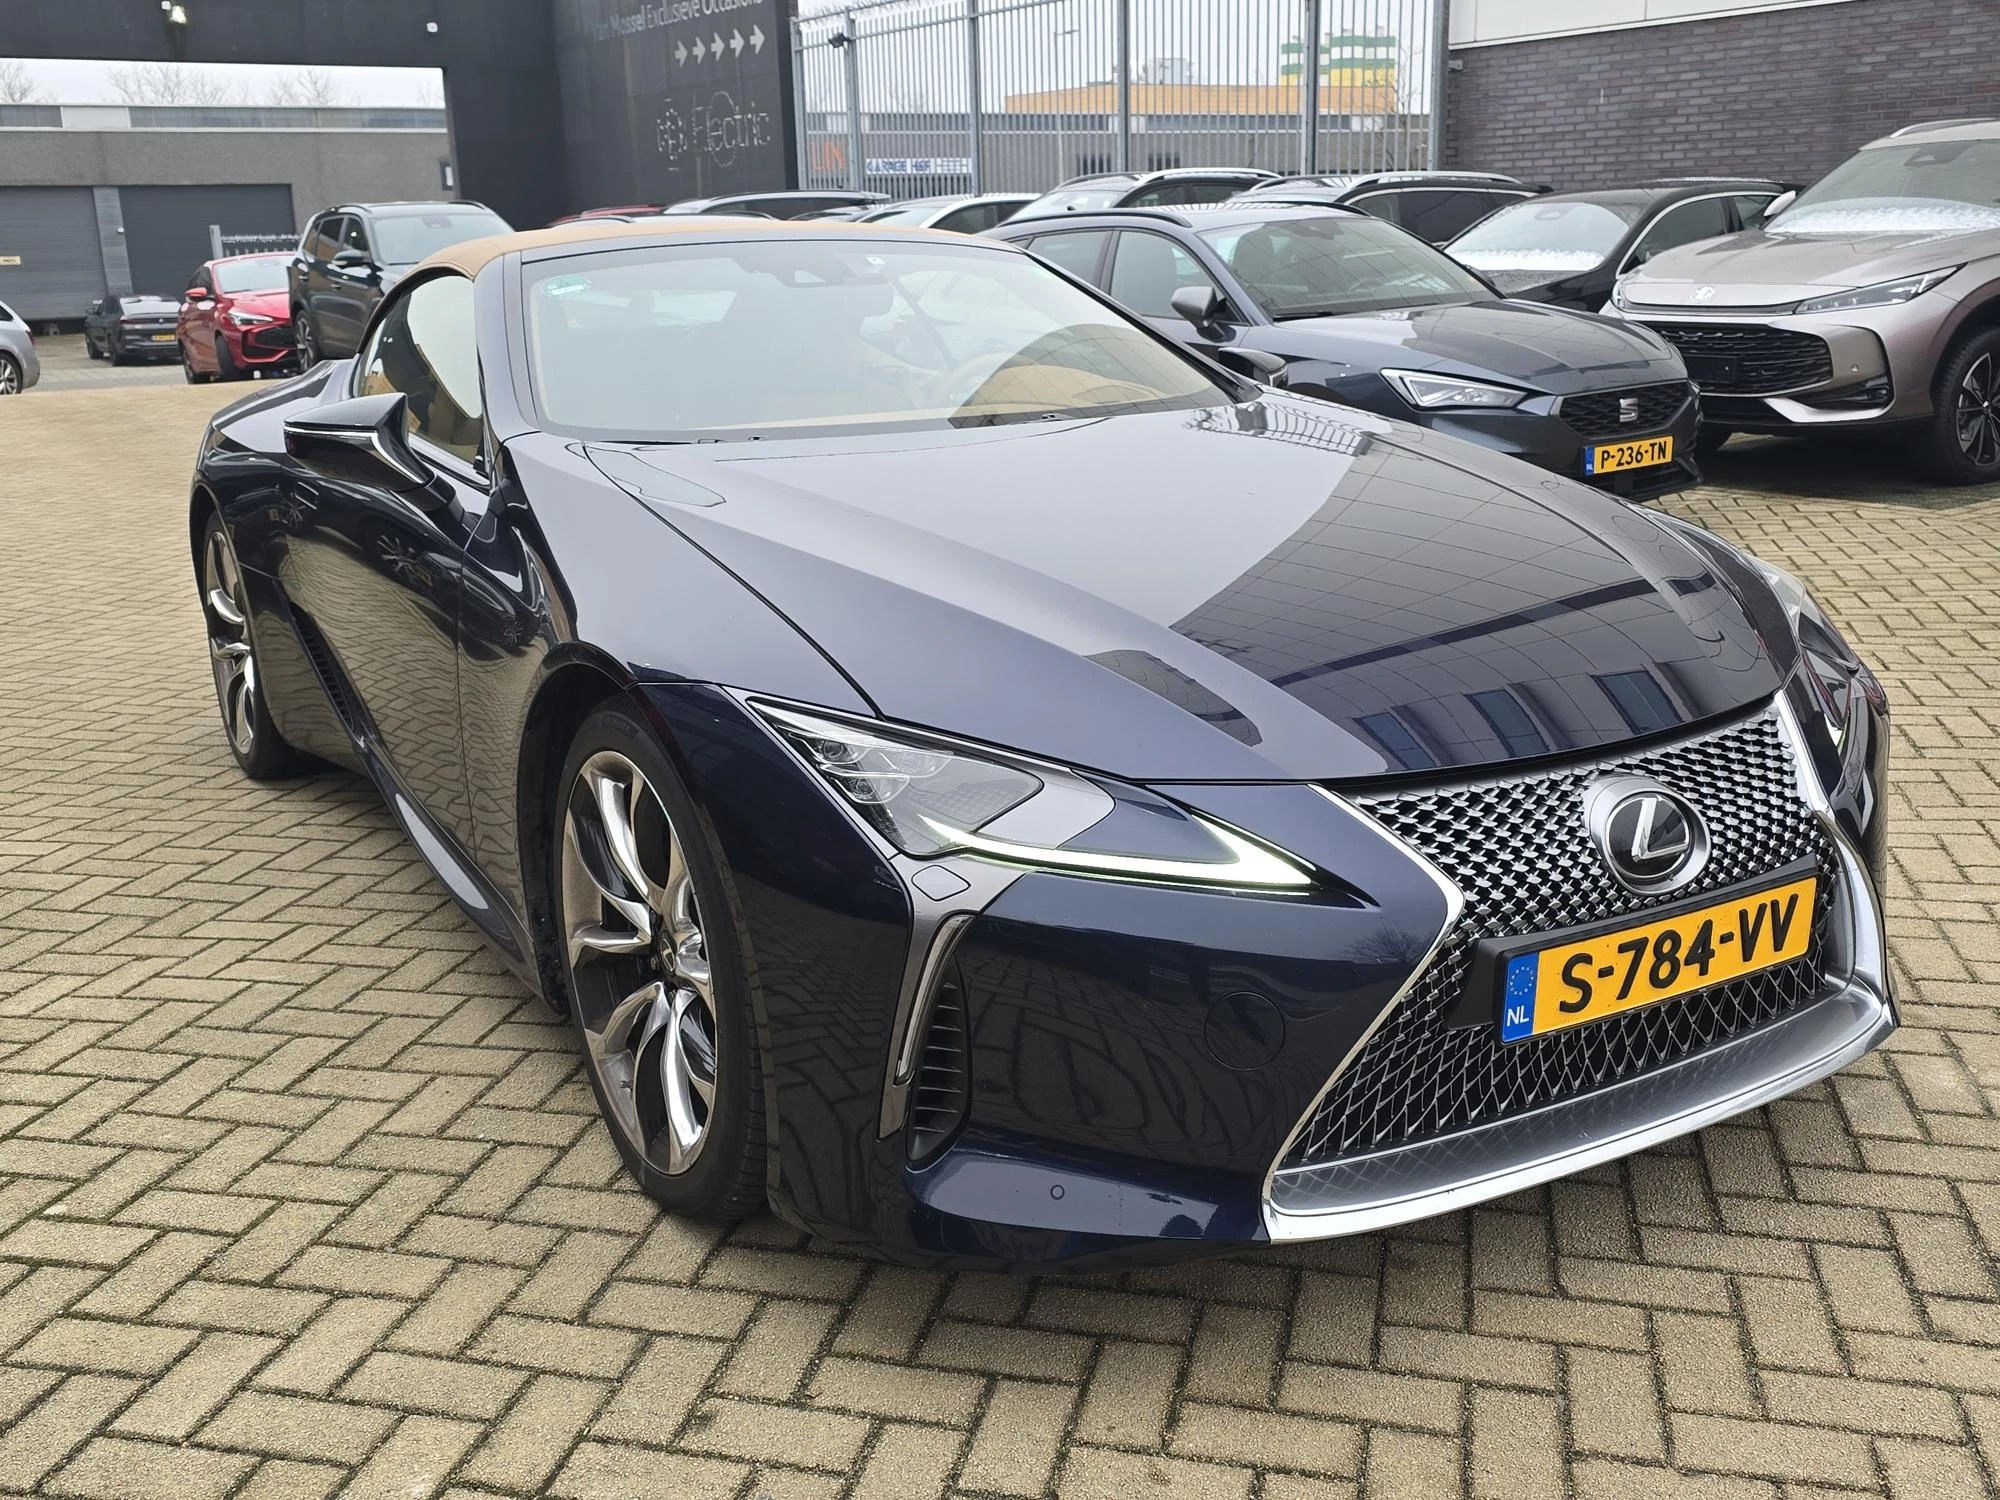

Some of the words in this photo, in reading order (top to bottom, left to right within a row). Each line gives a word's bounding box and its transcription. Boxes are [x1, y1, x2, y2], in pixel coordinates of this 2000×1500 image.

[1601, 441, 1667, 469] P-236-TN
[1559, 893, 1799, 1013] S-784-VV
[1506, 1006, 1530, 1027] NL
